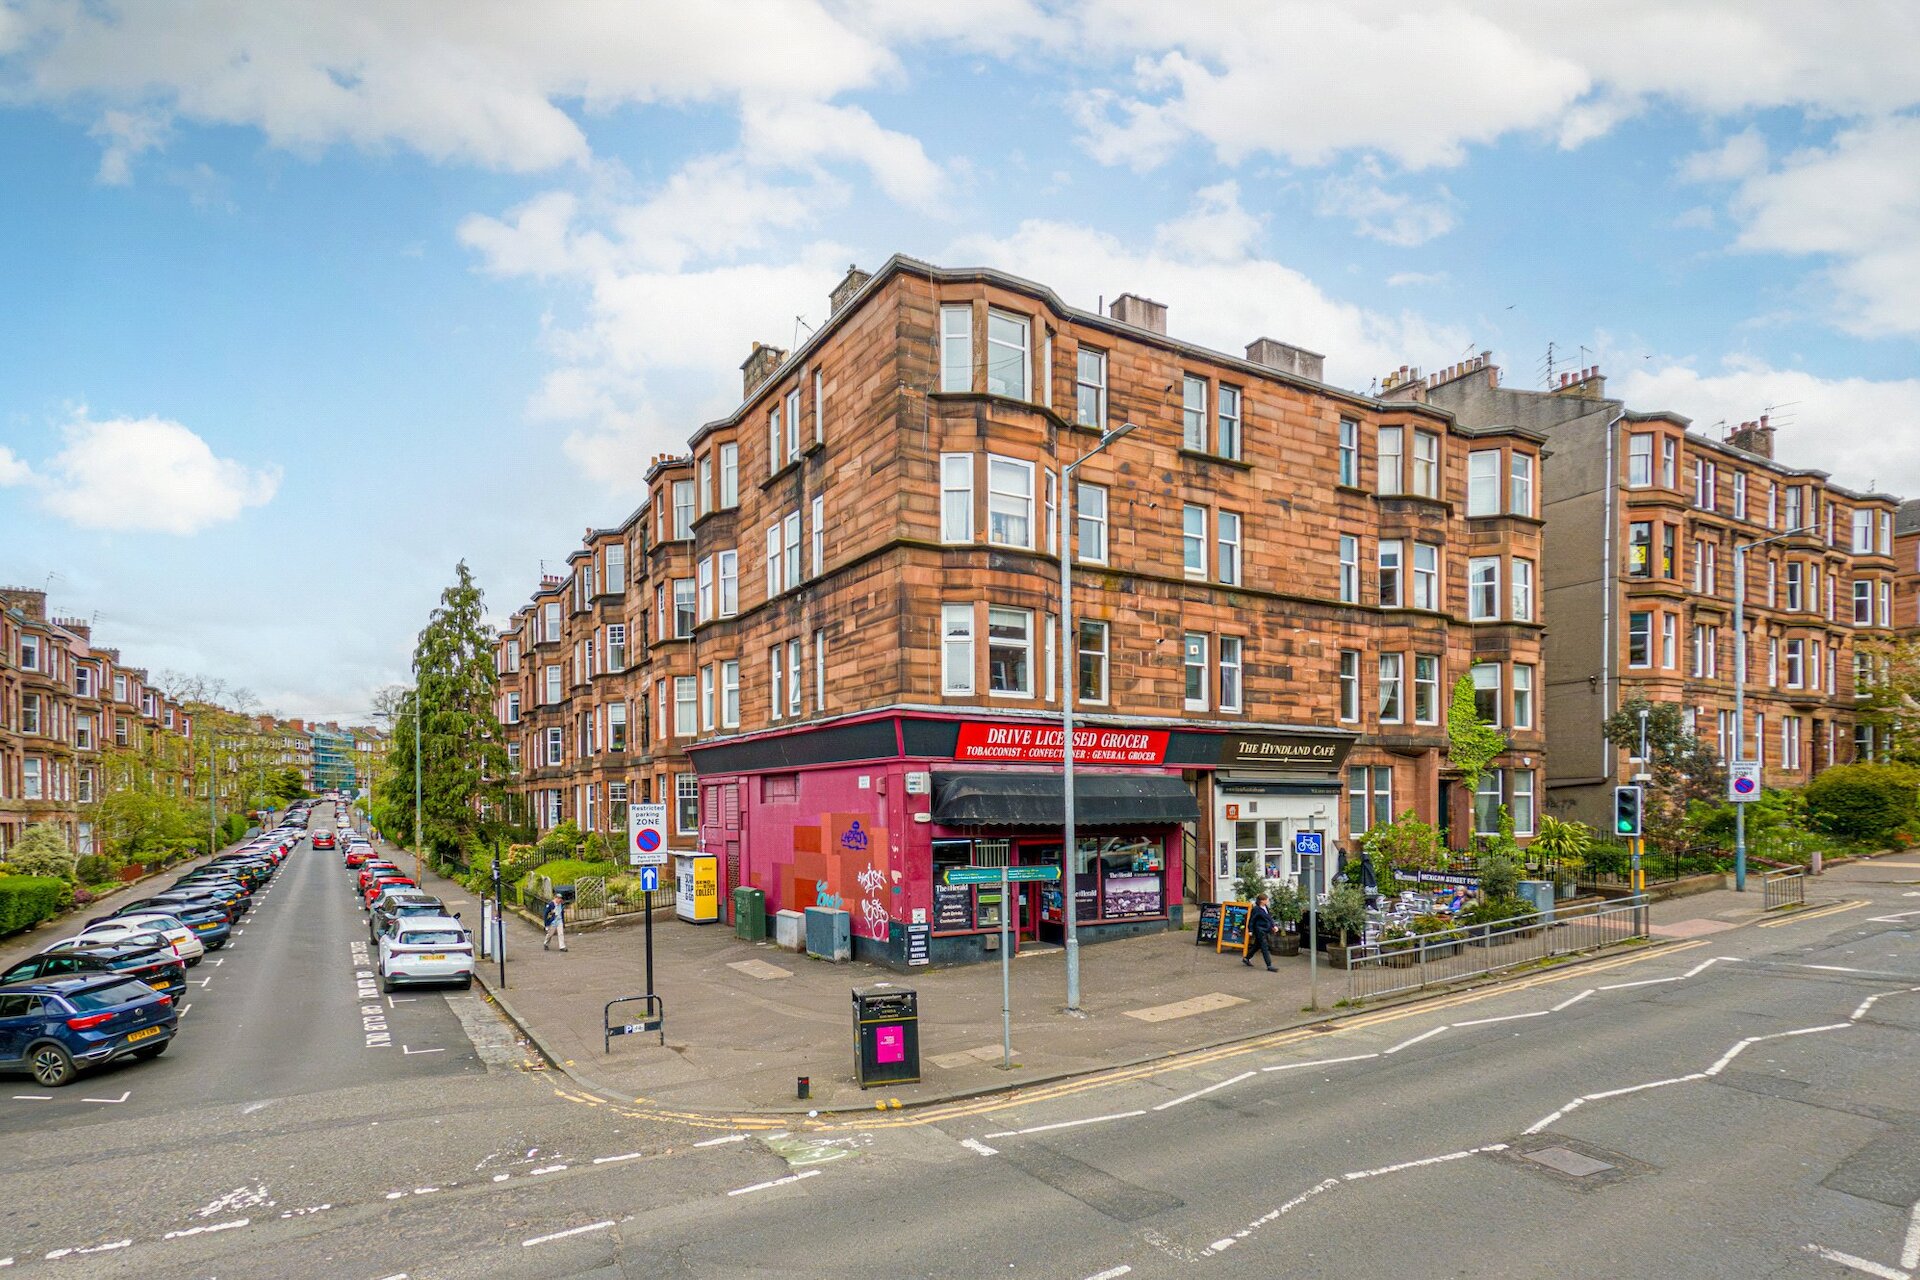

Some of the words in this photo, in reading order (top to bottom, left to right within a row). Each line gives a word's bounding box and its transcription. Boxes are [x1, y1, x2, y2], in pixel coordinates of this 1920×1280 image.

[987, 728, 1032, 745] DRIVE
[1035, 730, 1096, 748] LICESED
[1101, 732, 1149, 749] GROCER
[966, 745, 1022, 758] TOBACCONIST
[1029, 747, 1086, 759] CONFECTINER
[1092, 749, 1126, 760] GENERAL
[1128, 751, 1156, 761] GROCER
[1260, 743, 1310, 756] HYNDLAND
[1313, 744, 1336, 757] CAFÉ
[1446, 876, 1466, 884] STREET
[685, 884, 694, 895] TAP
[695, 888, 715, 897] COLLECT
[950, 883, 968, 892] Herald
[1081, 889, 1097, 897] Herald
